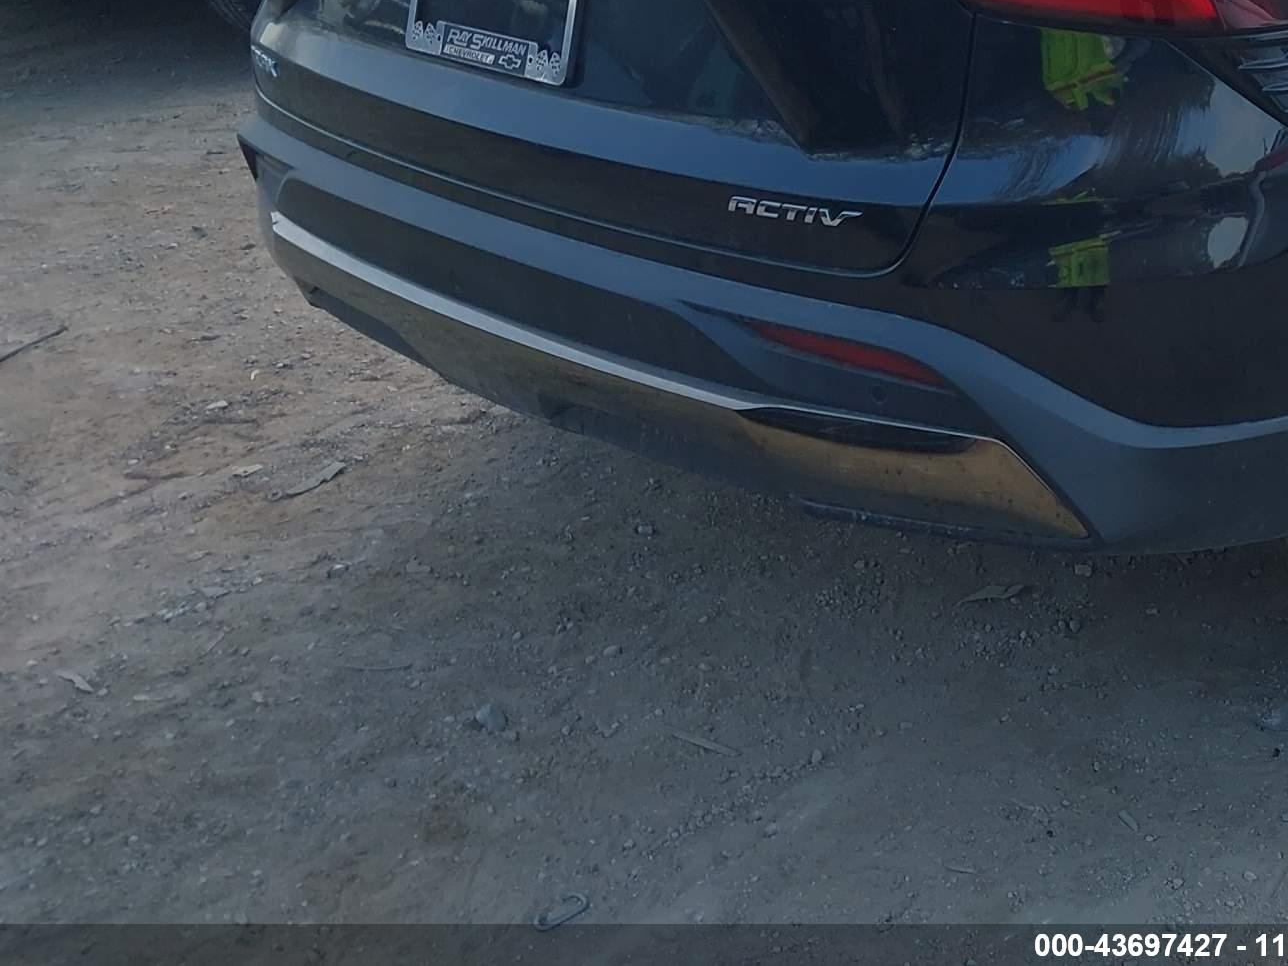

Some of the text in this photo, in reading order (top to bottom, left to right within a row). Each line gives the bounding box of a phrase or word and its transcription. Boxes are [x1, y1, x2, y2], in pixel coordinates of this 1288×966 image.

[447, 28, 527, 56] RAY SKILLMAN
[728, 195, 863, 227] ACTIV
